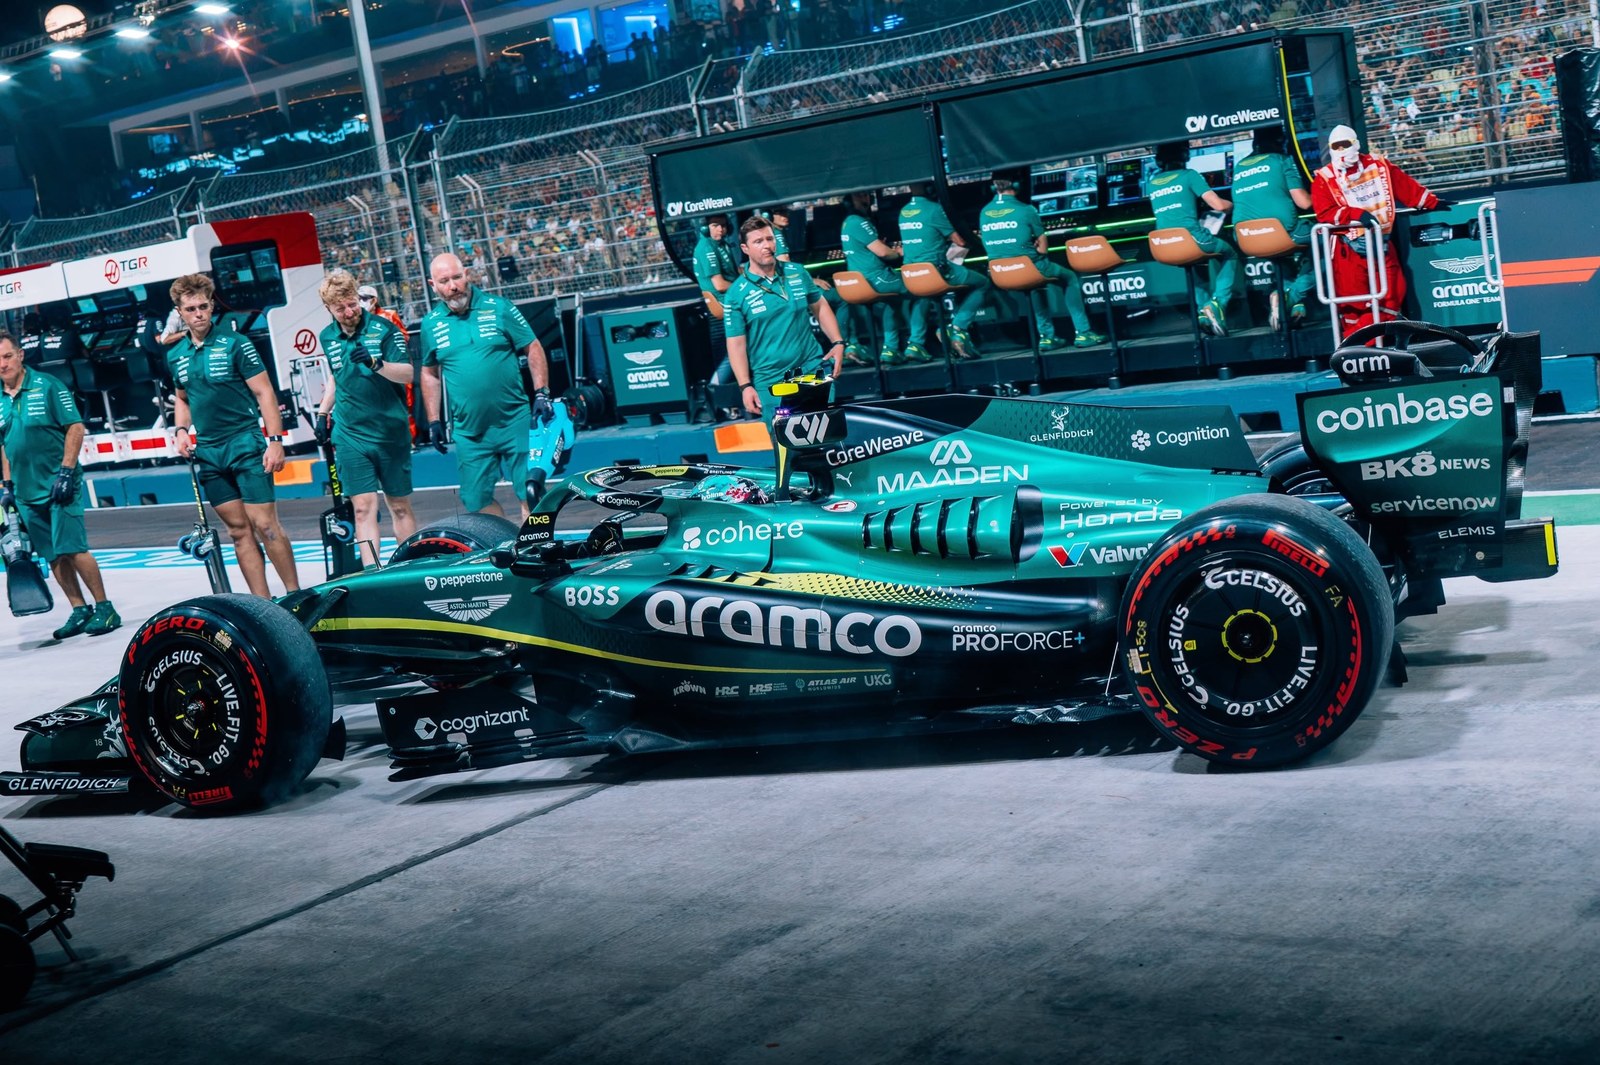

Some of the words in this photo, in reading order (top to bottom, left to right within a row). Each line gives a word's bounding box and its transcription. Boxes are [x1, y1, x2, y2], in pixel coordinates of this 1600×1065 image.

[1210, 106, 1279, 128] CoreWeave
[685, 196, 732, 212] CoreWeave
[120, 256, 148, 271] TGR
[1432, 281, 1500, 299] aramco
[1342, 354, 1391, 375] arm
[627, 369, 668, 383] aramco
[1316, 392, 1493, 434] coinbase
[1030, 429, 1094, 442] GLENFIDDICH
[1156, 425, 1230, 447] Cognition
[826, 430, 924, 467] CoreWeave
[1360, 450, 1437, 481] BK8
[1440, 458, 1491, 471] NEWS
[330, 463, 340, 496] REAR
[877, 465, 1028, 495] MAADEN
[606, 496, 640, 507] Cognition
[1060, 498, 1136, 511] Powered
[1142, 498, 1163, 506] by
[1371, 496, 1496, 514] servicenow
[1060, 506, 1182, 530] Honda
[520, 531, 550, 542] aramco
[705, 519, 804, 546] cohere
[1438, 526, 1496, 540] ELEMIS
[1089, 543, 1153, 565] Valvo
[1261, 528, 1331, 578] PIRELLI
[440, 571, 504, 588] pepperstone
[564, 586, 620, 607] BOSS
[1226, 569, 1307, 617] CELSIUS
[449, 602, 467, 610] ASTON
[467, 600, 488, 608] MARTIN
[141, 615, 206, 646] ZERO
[645, 590, 922, 658] aramco
[952, 625, 997, 633] aramco
[952, 630, 1085, 651] PROFORCE+
[1169, 604, 1200, 688] CELSIUS
[153, 650, 203, 680] CELSIUS
[673, 680, 707, 697] KROWN
[715, 685, 739, 696] HRC
[749, 682, 773, 693] HRS
[807, 678, 838, 687] ATLAS
[864, 673, 892, 687] UKG
[440, 706, 530, 735] cognizant
[1136, 685, 1224, 756] ZERO
[94, 737, 103, 747] 18
[8, 777, 121, 791] GLENFIDDICH
[188, 785, 234, 806] PIRELLI
